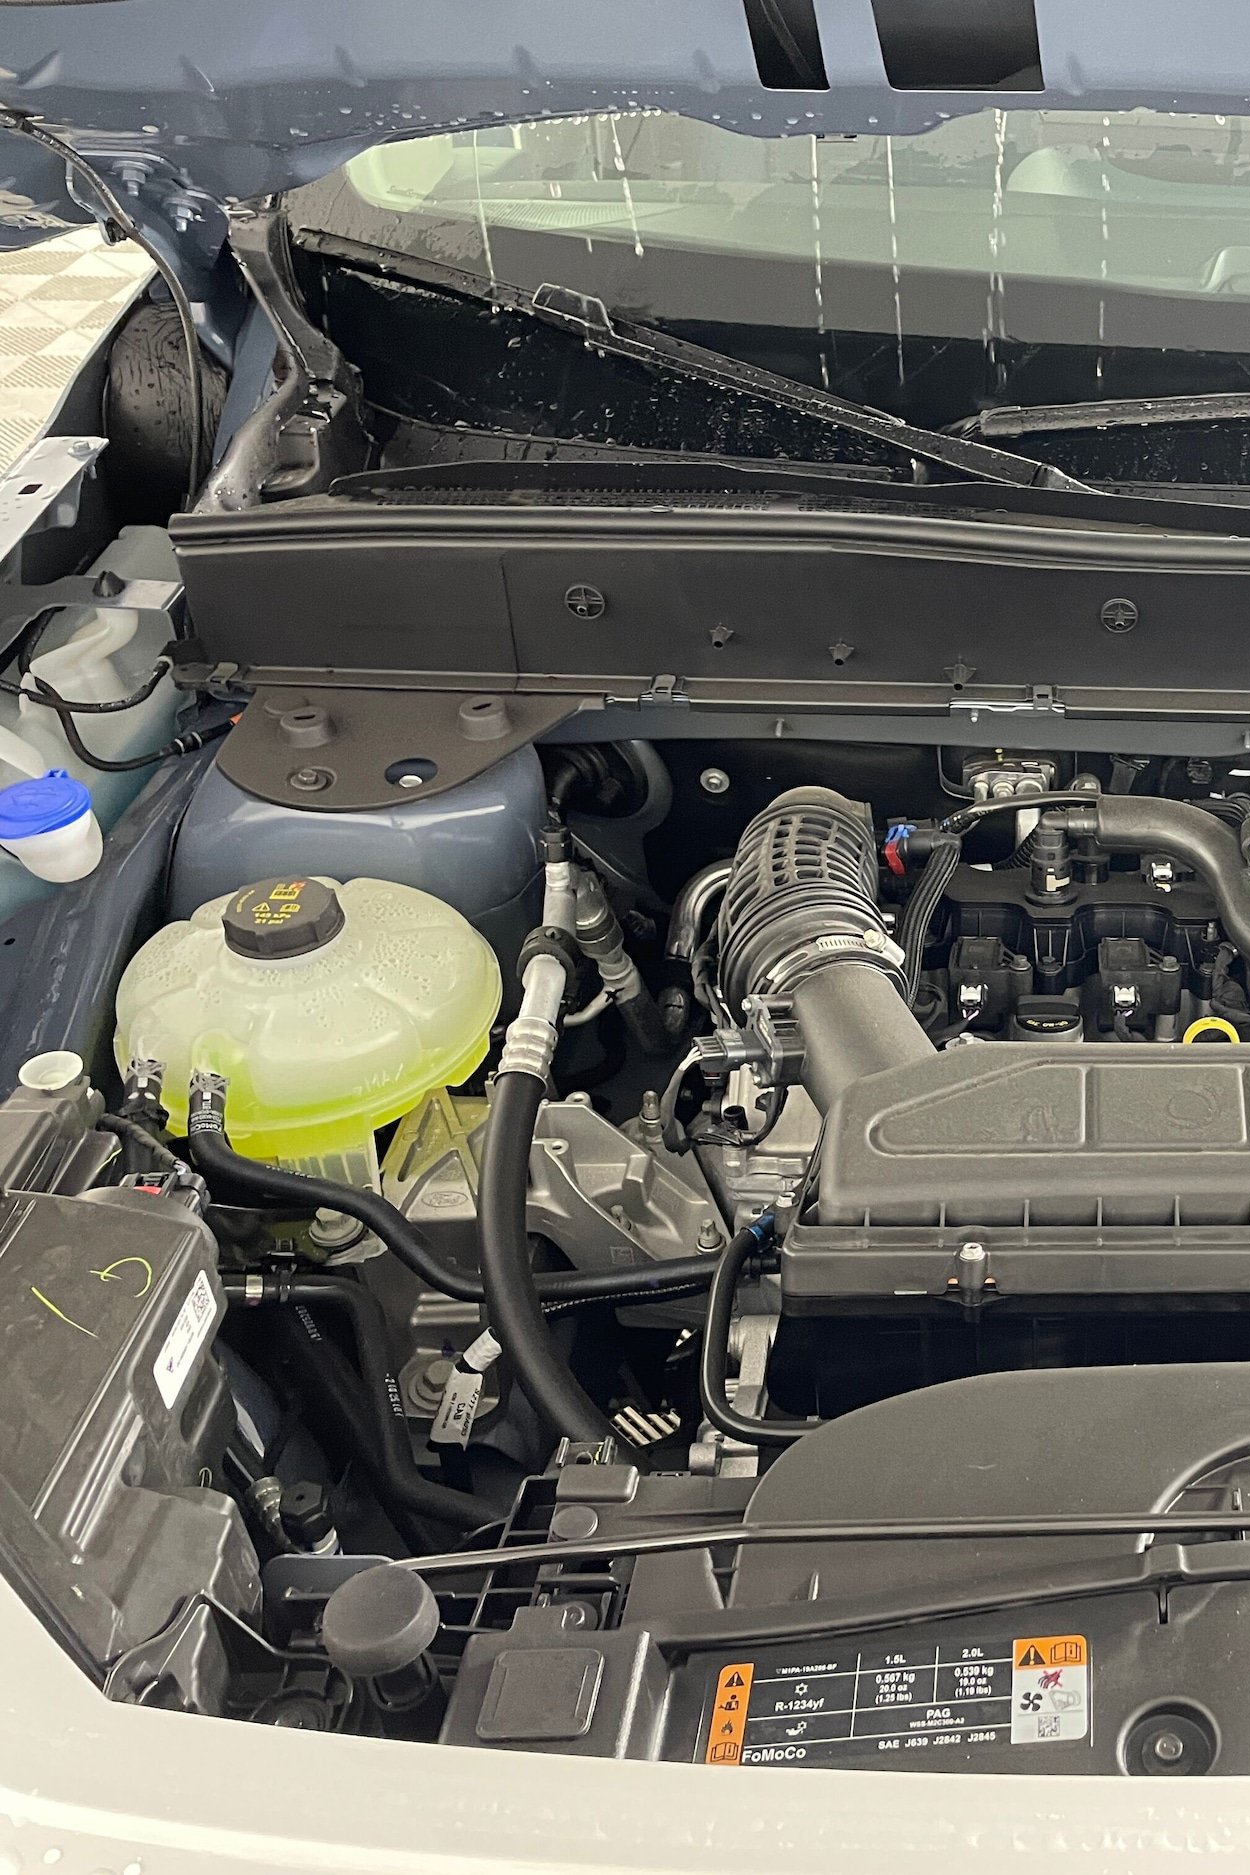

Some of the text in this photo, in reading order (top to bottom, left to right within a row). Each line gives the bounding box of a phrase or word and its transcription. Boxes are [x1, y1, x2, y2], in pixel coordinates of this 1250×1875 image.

[884, 1647, 985, 1665] 1.5L 2.0L
[981, 1665, 995, 1677] kg
[875, 1672, 916, 1684] 0.567 kg
[958, 1677, 987, 1687] 19.0 oz
[878, 1684, 908, 1693] 20.0 oz
[976, 1685, 992, 1696] lbs)
[896, 1692, 913, 1703] lbs)
[775, 1698, 825, 1712] R-1234yf
[926, 1708, 951, 1719] PAG
[878, 1731, 996, 1750] SAE J639 J2842 J2845
[741, 1746, 807, 1763] FoMoCo
